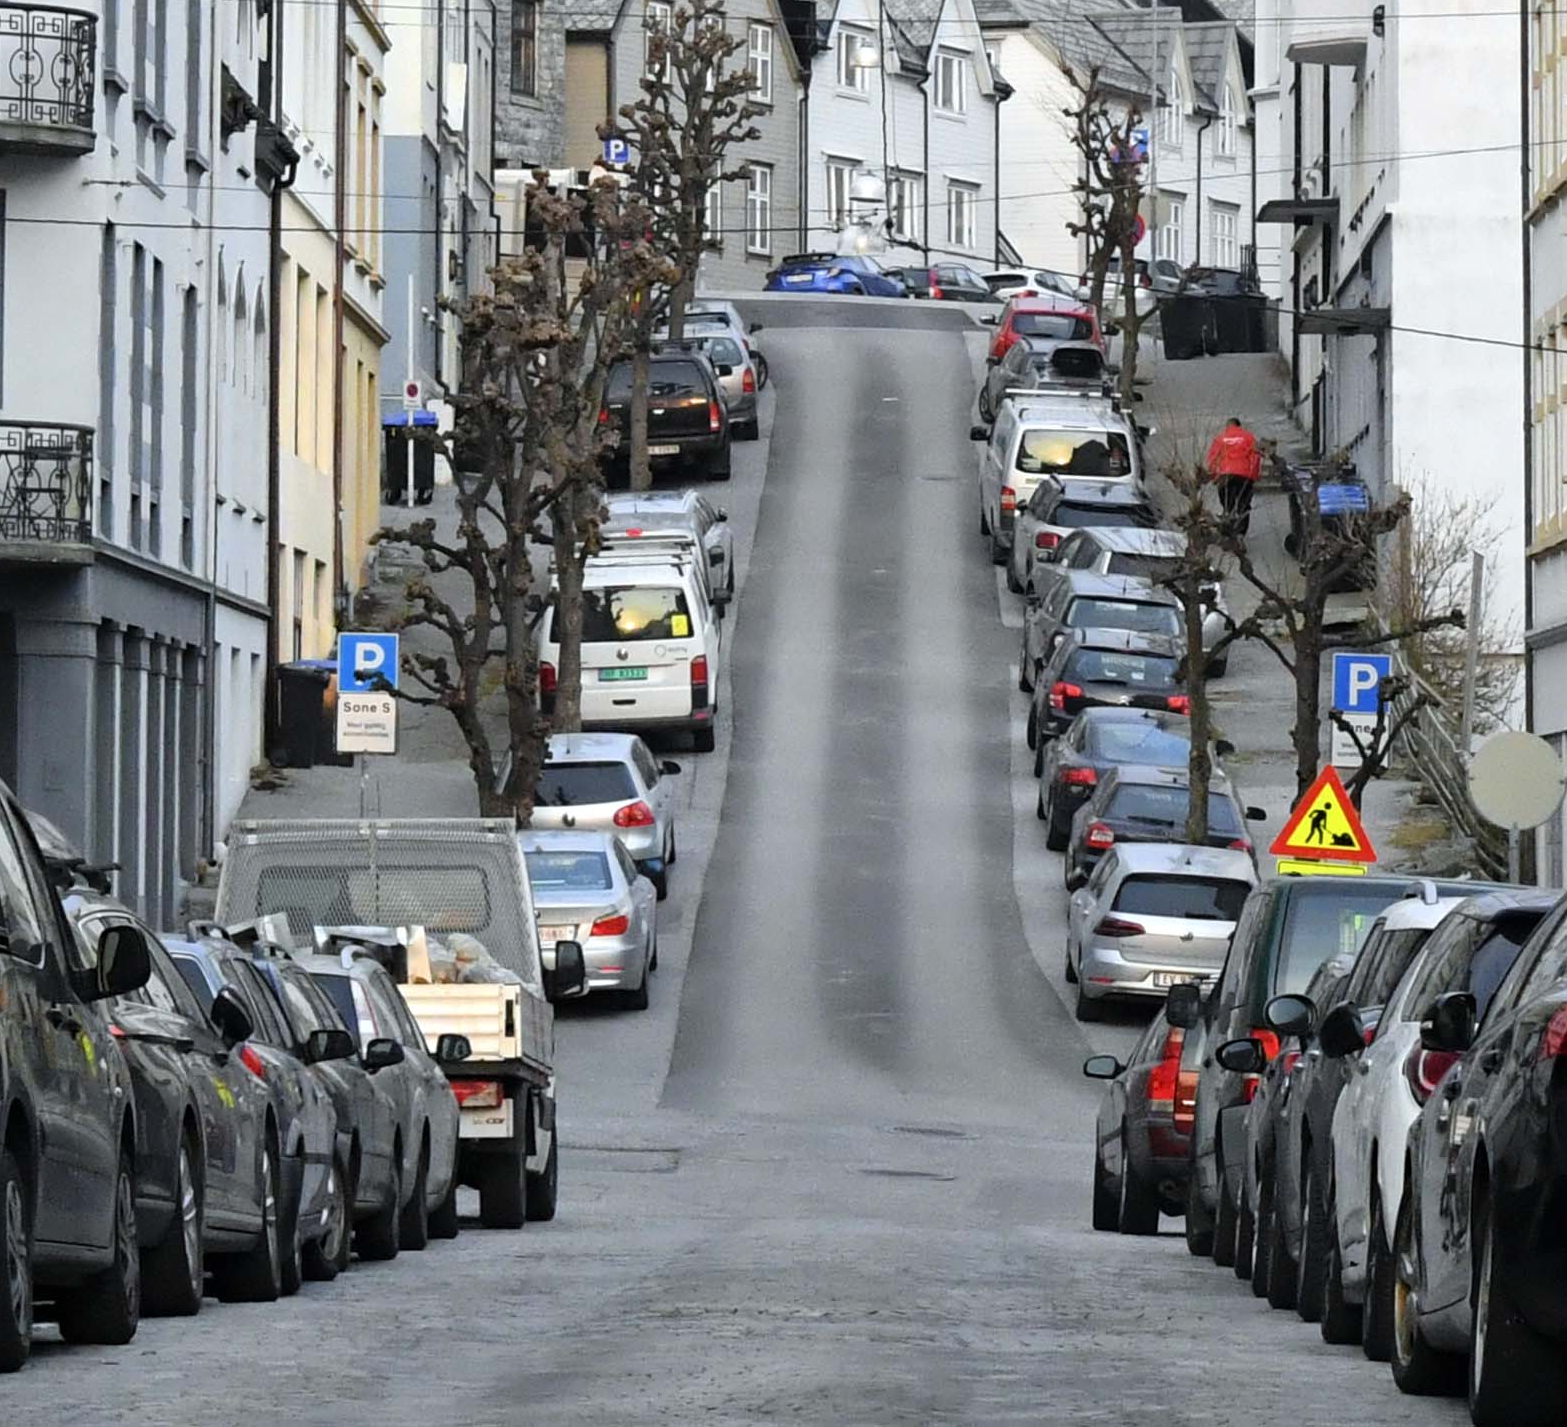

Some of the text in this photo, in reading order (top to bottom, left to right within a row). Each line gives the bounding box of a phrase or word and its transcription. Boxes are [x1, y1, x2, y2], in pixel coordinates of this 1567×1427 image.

[610, 139, 624, 160] P
[355, 642, 385, 686] P
[1349, 663, 1378, 706] P
[343, 702, 391, 713] Sone S
